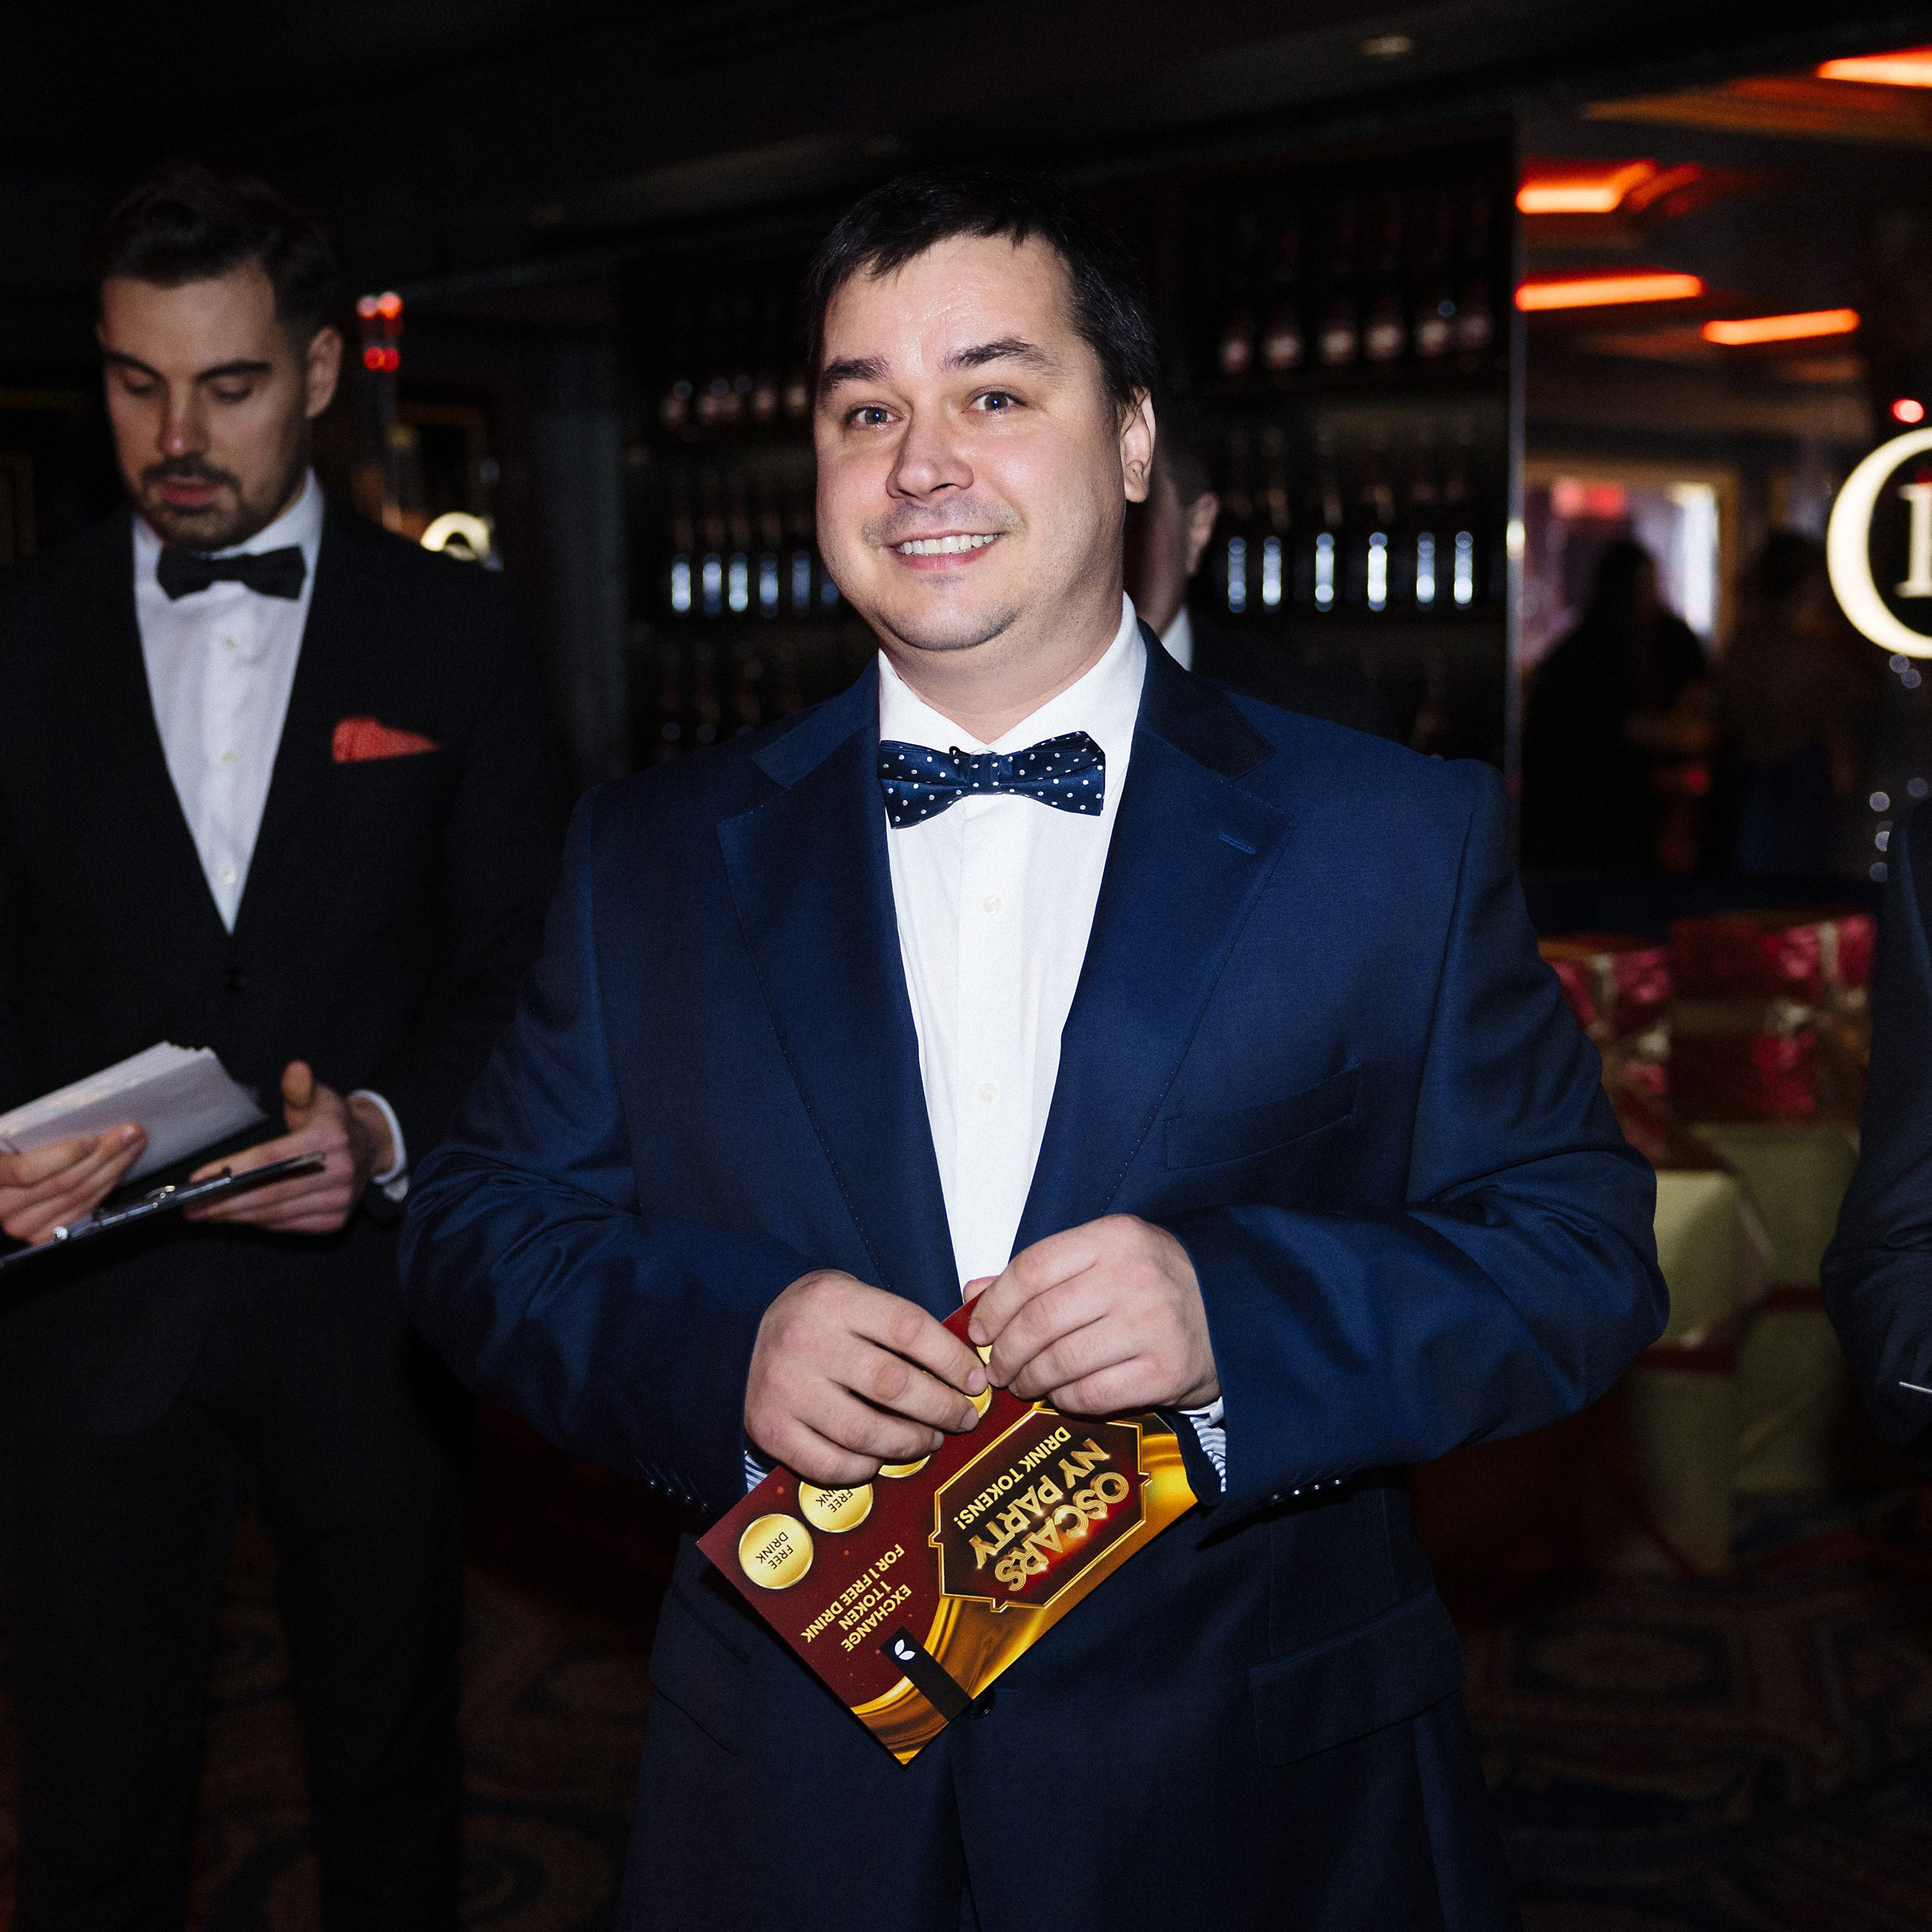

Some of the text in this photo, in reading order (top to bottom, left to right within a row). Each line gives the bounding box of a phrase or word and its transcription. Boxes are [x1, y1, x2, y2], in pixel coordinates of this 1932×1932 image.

[828, 1489, 854, 1513] FREE
[953, 1426, 1072, 1530] DRINK TOKENS!
[968, 1438, 1109, 1569] NY PARTY
[755, 1531, 789, 1564] DRINK
[768, 1544, 794, 1570] FREE
[995, 1472, 1128, 1591] OSCARS
[801, 1543, 905, 1643] FOR 1 FREE DRINK
[838, 1580, 891, 1630] 1 TOKEN
[841, 1584, 912, 1652] EXCHANGE
